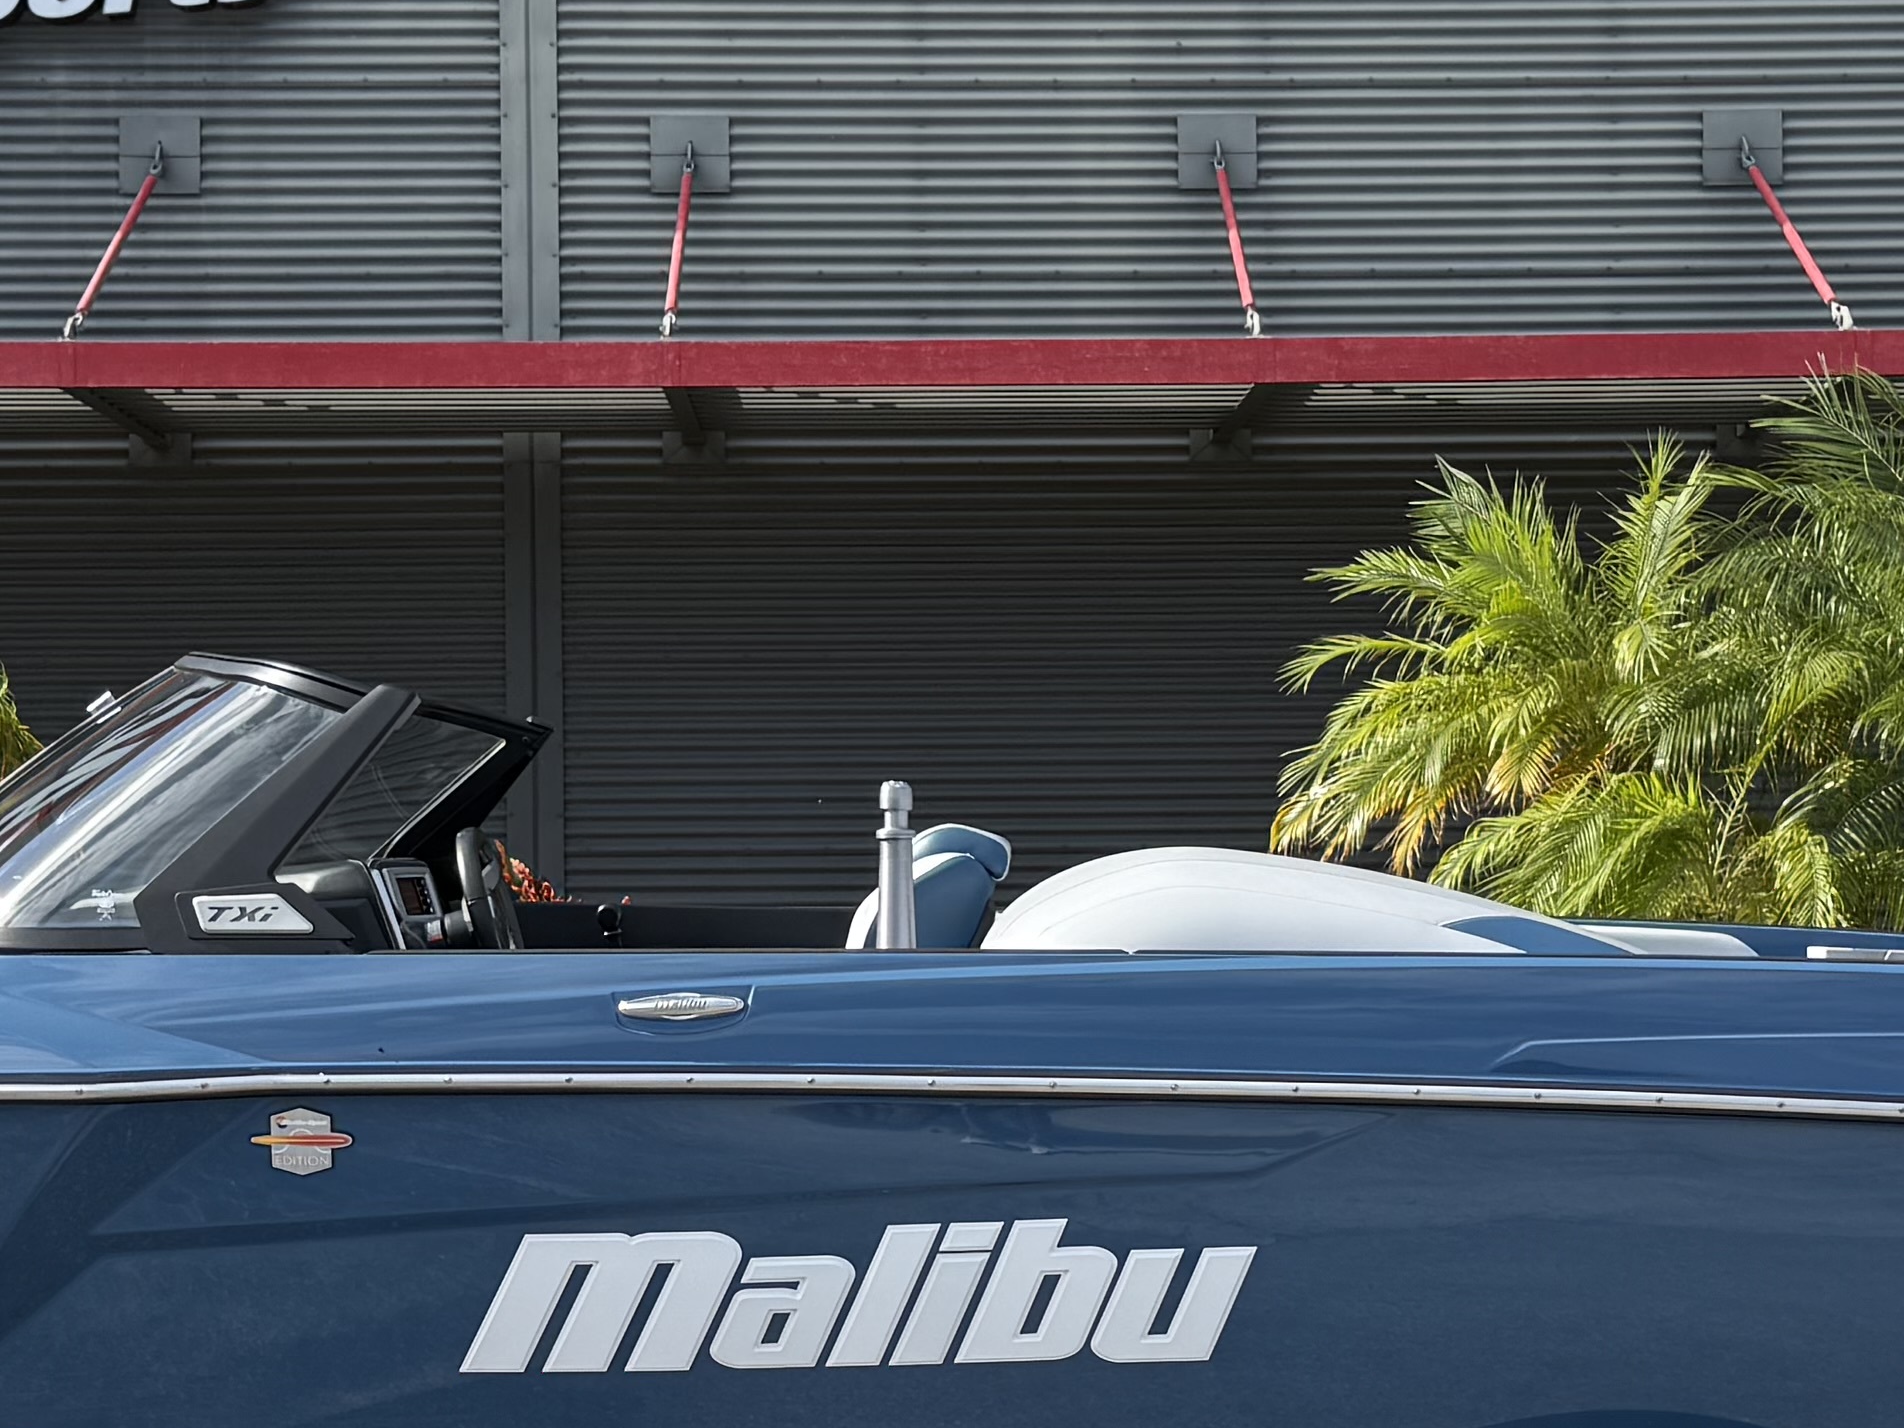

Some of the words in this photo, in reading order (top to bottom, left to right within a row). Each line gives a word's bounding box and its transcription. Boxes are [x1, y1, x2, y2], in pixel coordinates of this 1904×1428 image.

[207, 906, 279, 923] TXi
[275, 1154, 330, 1166] EDITION
[458, 1217, 1258, 1373] Malibu
